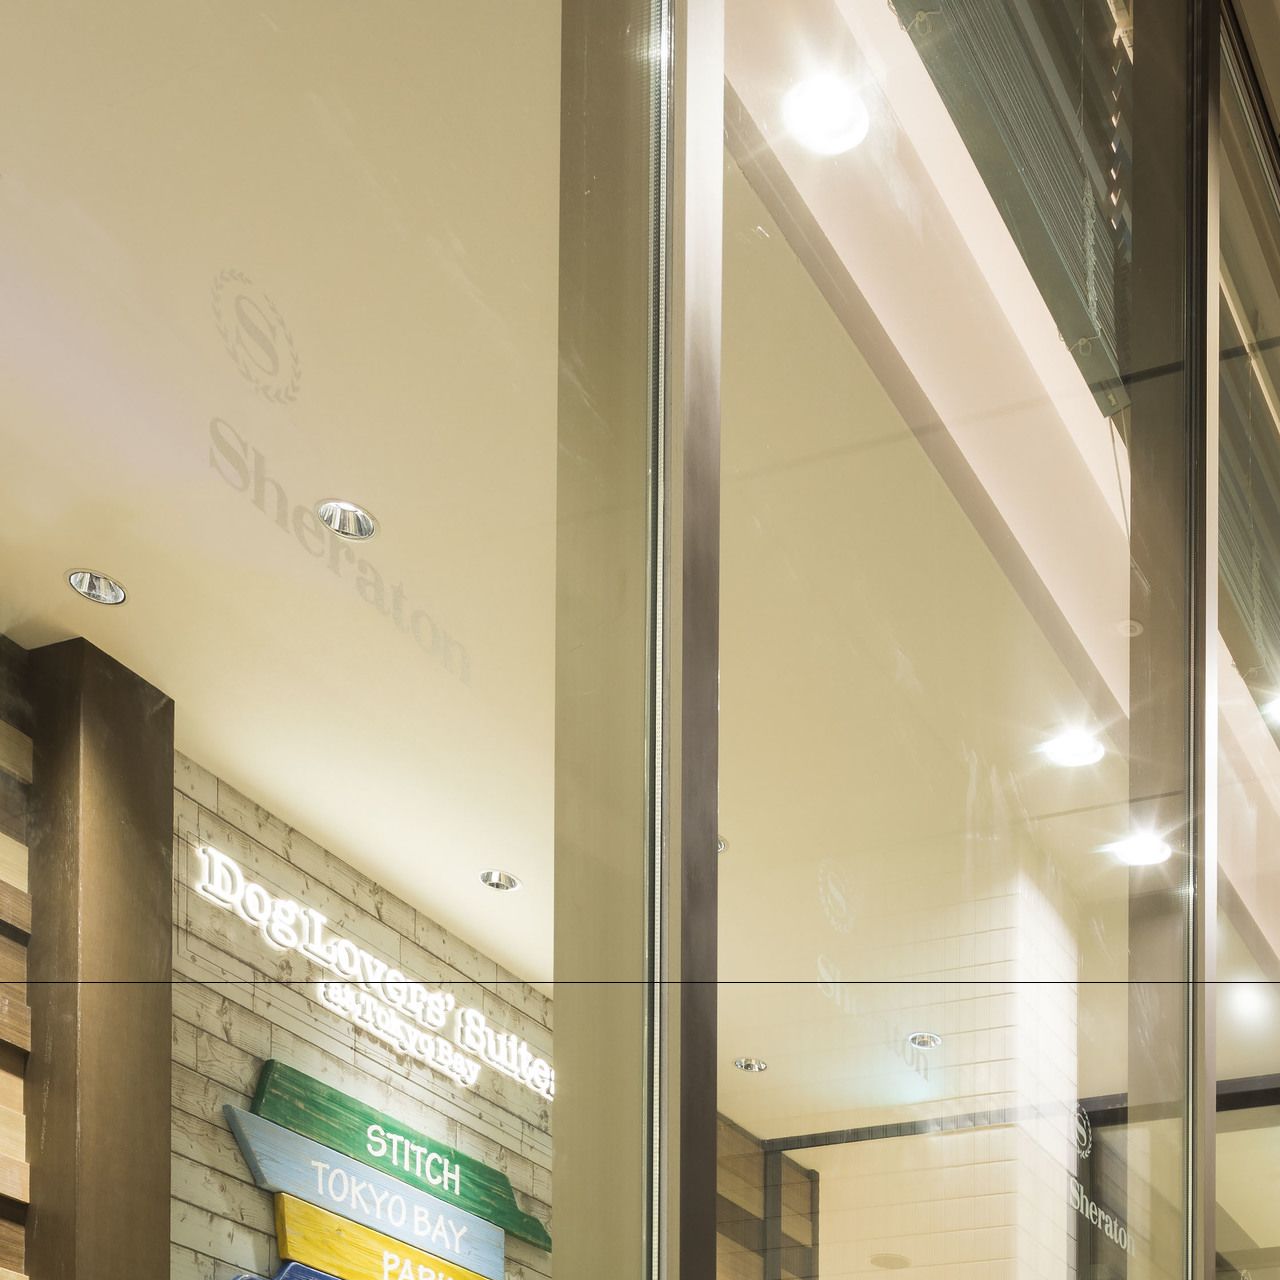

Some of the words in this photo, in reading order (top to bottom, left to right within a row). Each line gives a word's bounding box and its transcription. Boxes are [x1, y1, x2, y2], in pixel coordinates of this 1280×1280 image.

[209, 416, 473, 687] Sheraton
[199, 847, 298, 949] Dog
[432, 1034, 480, 1085] Bay
[367, 1125, 461, 1195] STITCH
[312, 1160, 408, 1227] TOKYO
[414, 1197, 468, 1254] BAY
[1070, 1177, 1137, 1257] Sheraton
